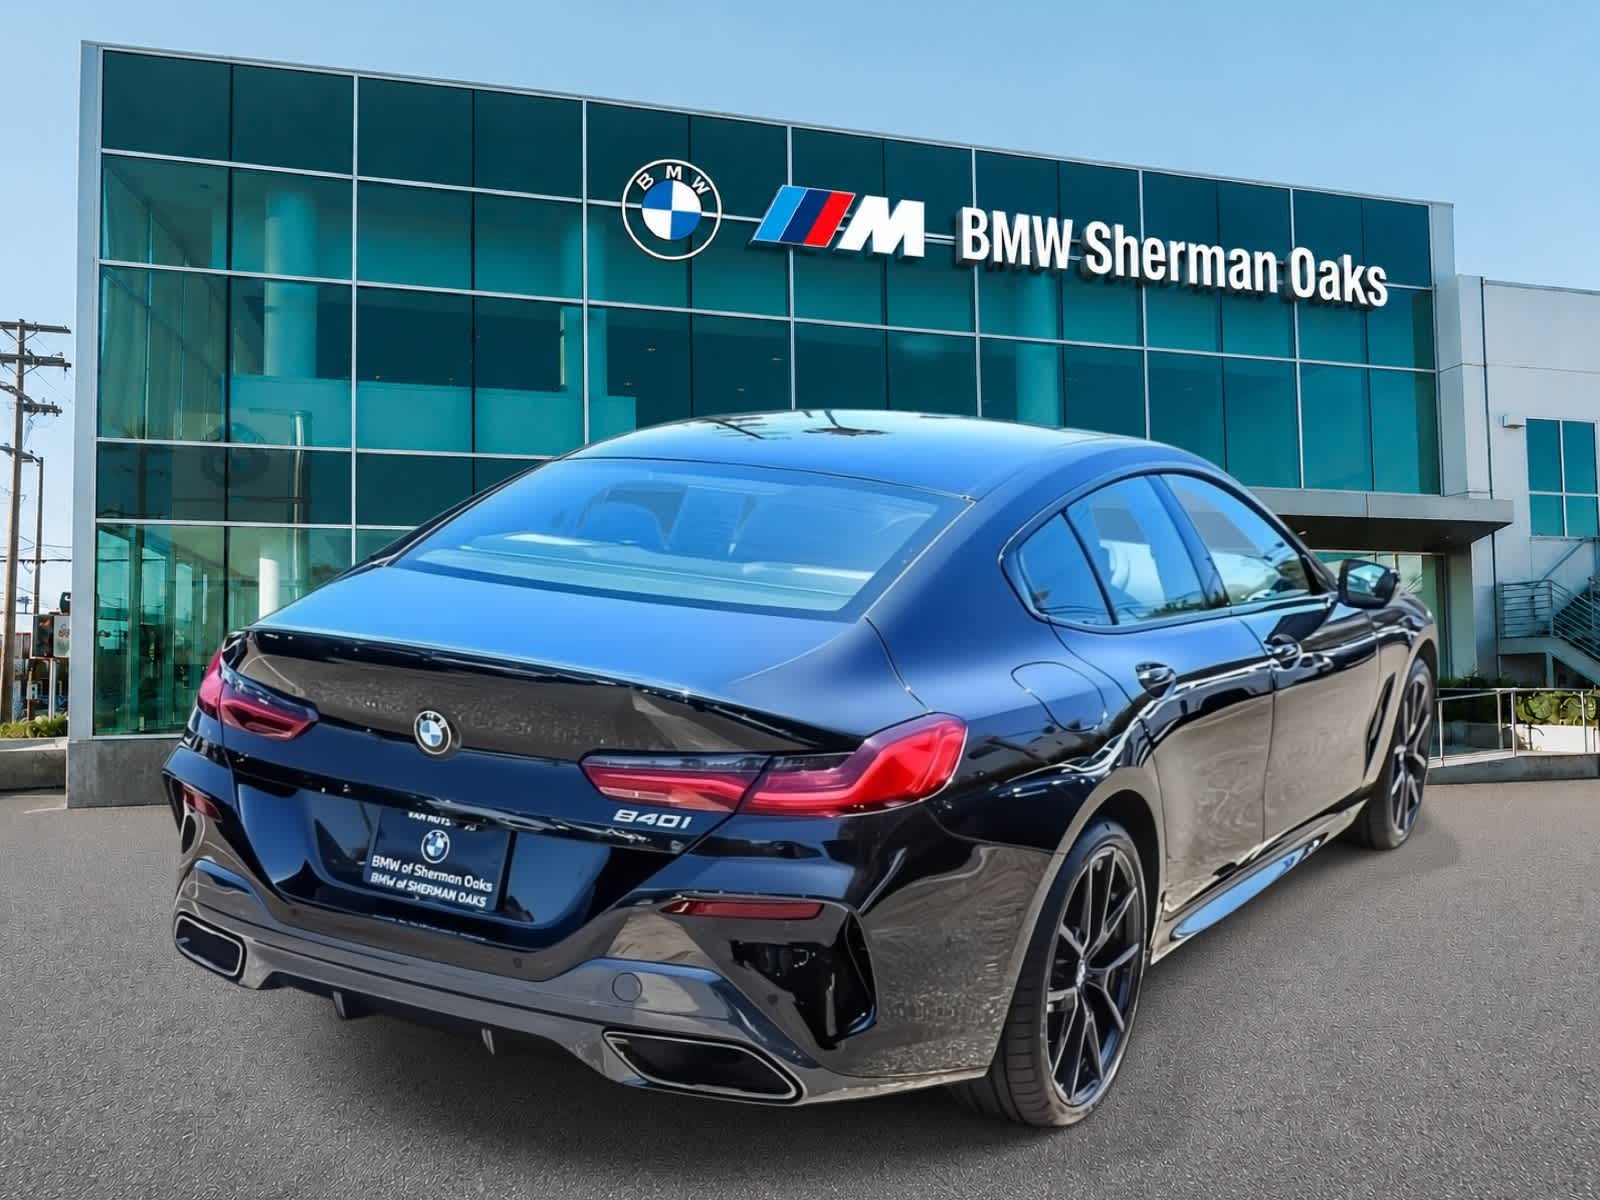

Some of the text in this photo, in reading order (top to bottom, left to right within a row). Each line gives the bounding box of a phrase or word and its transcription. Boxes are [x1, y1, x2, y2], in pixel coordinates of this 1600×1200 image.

[635, 165, 711, 196] BMW
[959, 206, 1389, 308] BMW Sherman Oaks
[370, 872, 487, 908] BMW of SHERMAN OAKS
[371, 855, 493, 892] BMW of Sherman Oaks
